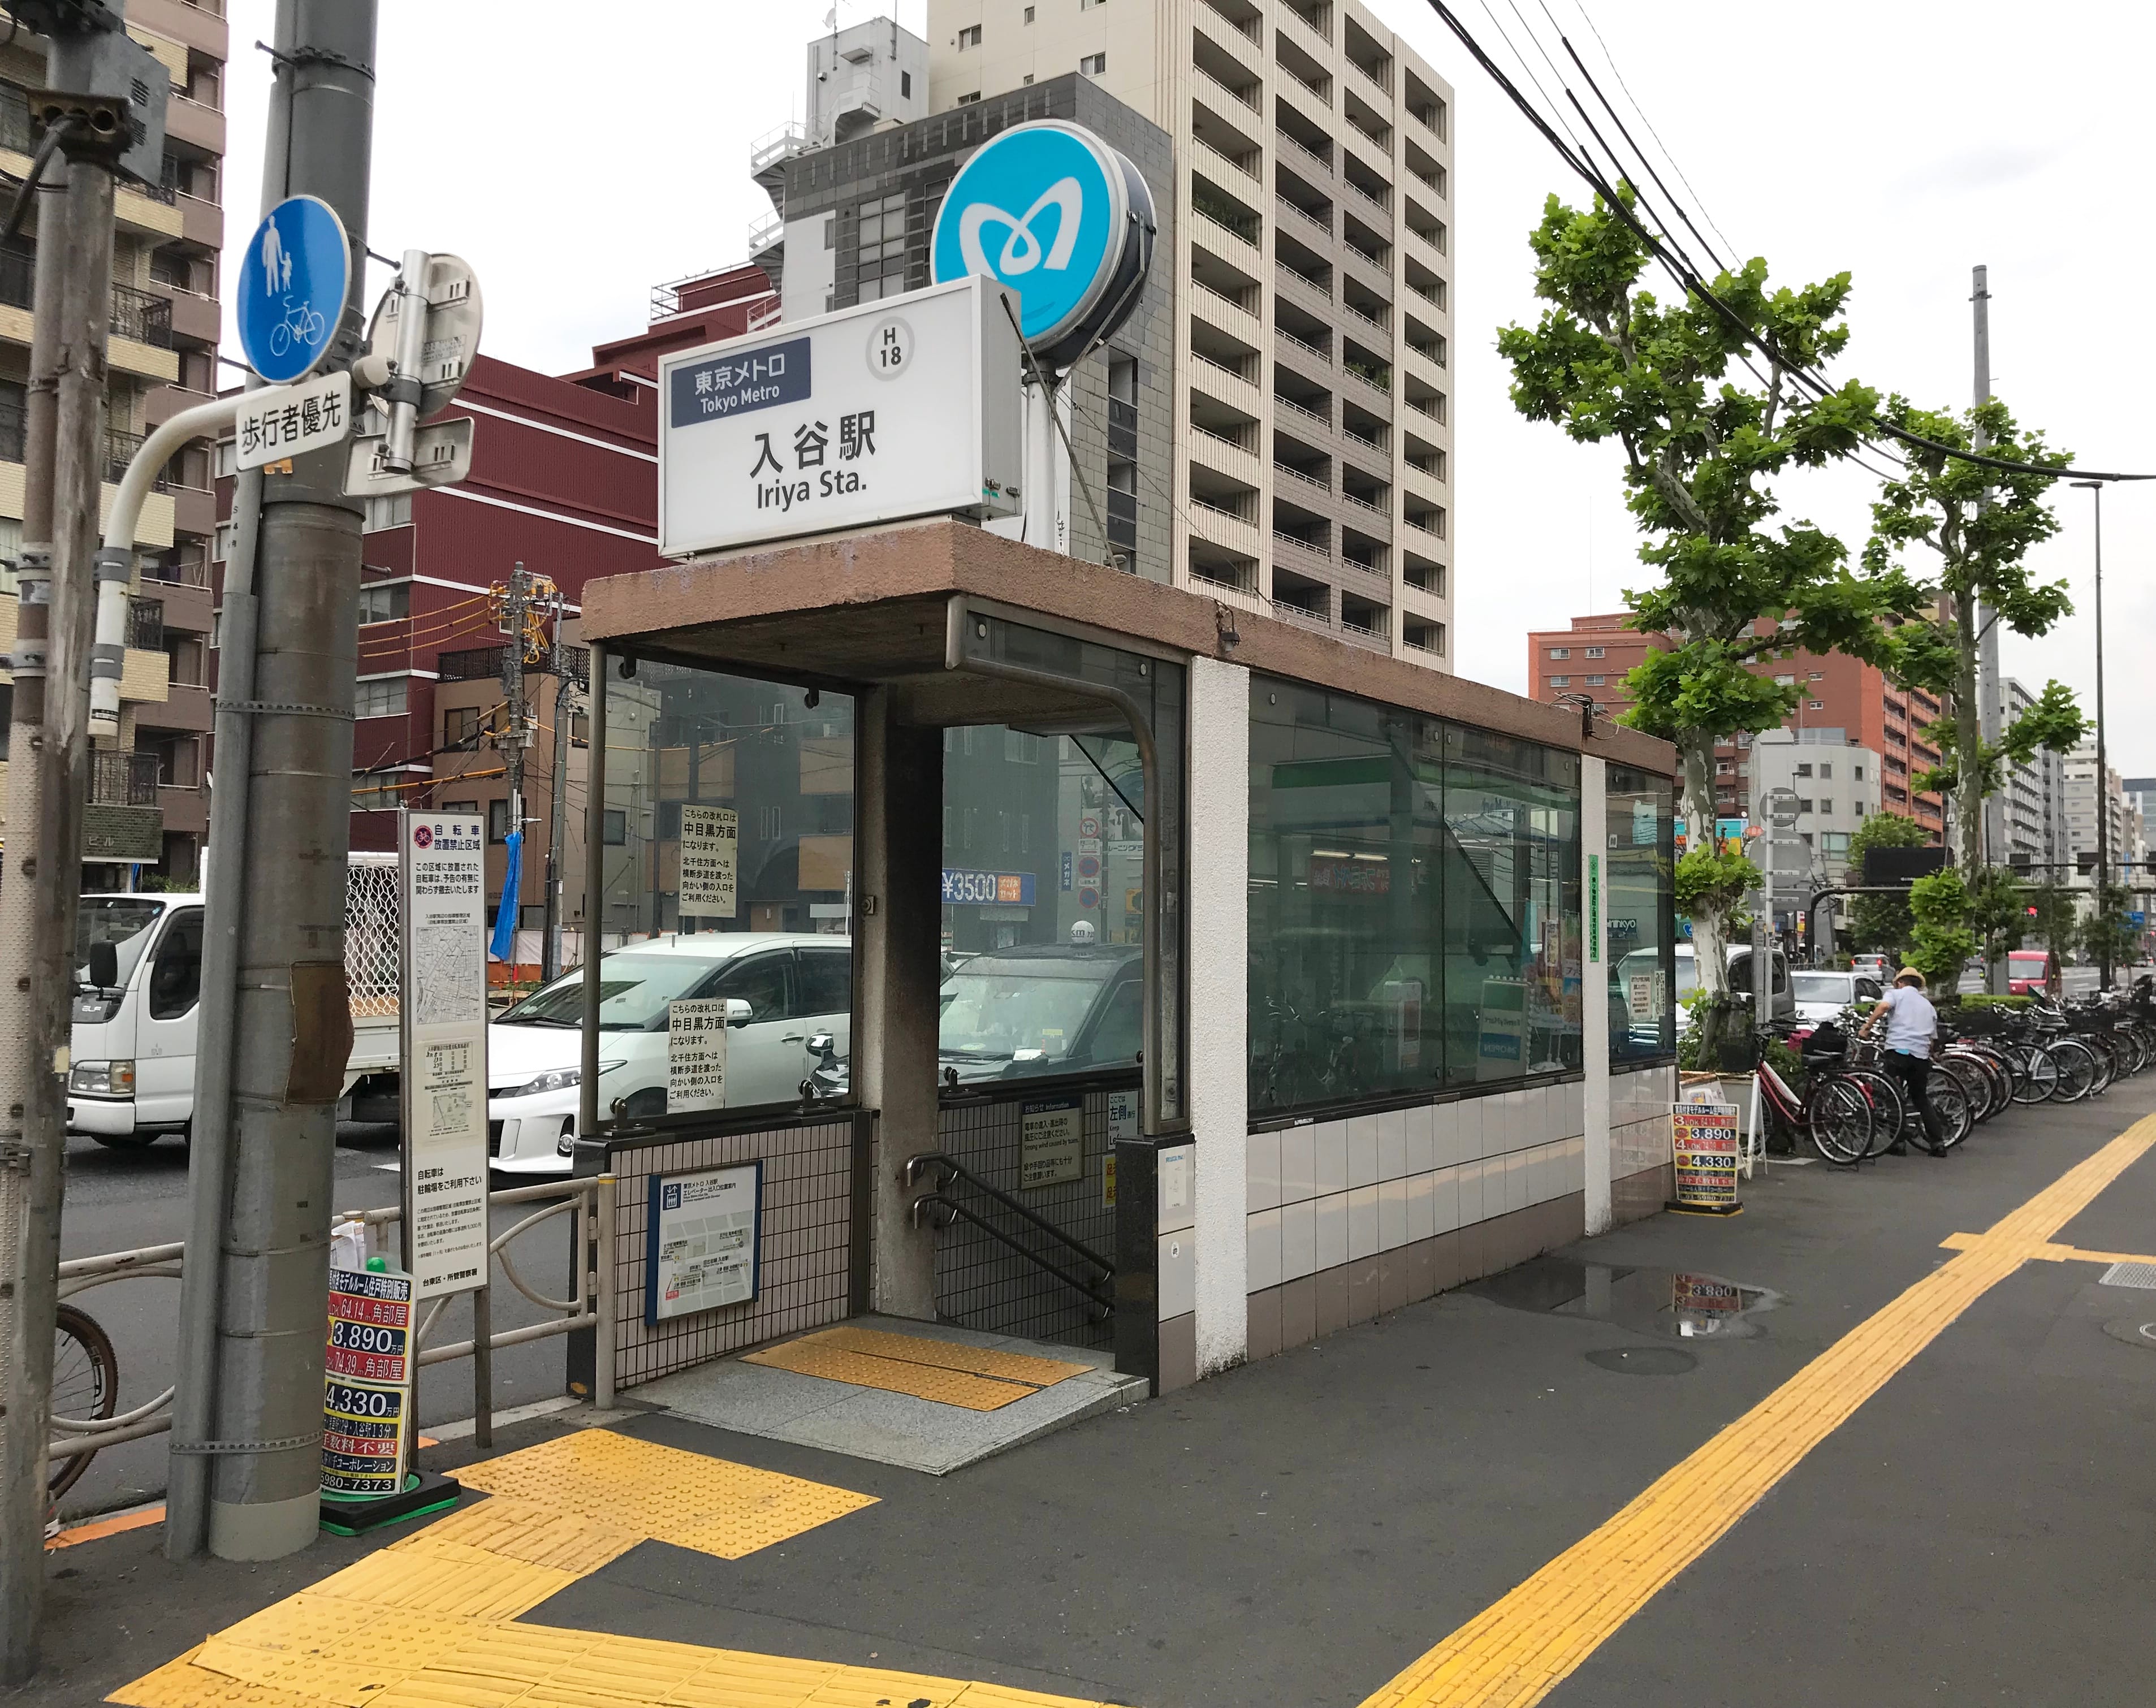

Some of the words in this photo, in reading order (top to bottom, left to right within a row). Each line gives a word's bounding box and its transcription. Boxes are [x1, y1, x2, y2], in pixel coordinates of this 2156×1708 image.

[883, 327, 896, 344] H
[880, 347, 901, 367] 18
[694, 353, 785, 396] 東京メトロ
[701, 389, 738, 414] Tokyo
[741, 384, 779, 406] Metro
[242, 390, 340, 455] 歩行者優先
[750, 410, 876, 479] 入谷駅
[758, 479, 809, 512] Iriya
[820, 470, 867, 498] Sta.
[685, 809, 736, 822] こちらの改札口は
[435, 825, 479, 836] 自転車
[684, 821, 736, 839] 中目黒方面
[434, 839, 480, 850] 放置禁止区域
[682, 840, 719, 852] になります。
[416, 863, 479, 871] この区域に放置された
[682, 857, 729, 868] 北千住方面へは
[682, 869, 733, 880] 横断歩道を渡った
[682, 881, 734, 892] 向かい側の入口を
[942, 872, 996, 901] ¥3500
[682, 893, 726, 904] ご利用ください。
[672, 1004, 725, 1014] こちらの改札口は
[672, 1017, 725, 1031] 中目黒方面
[671, 1035, 707, 1046] になります。
[671, 1052, 718, 1062] 北千住方面へは
[670, 1063, 721, 1075] 横断歩道を渡った
[670, 1075, 723, 1087] 向かい側の入口を
[669, 1088, 714, 1099] ご利用ください。
[1025, 1104, 1044, 1113] お知らせ
[1109, 1104, 1135, 1121] 左側通行
[1109, 1134, 1122, 1145] Le
[418, 1168, 444, 1181] 自転車は
[417, 1176, 482, 1195] 駐輪場をご利用下さい
[371, 1303, 407, 1325] 角部屋
[365, 1357, 403, 1380] 角部屋
[323, 1433, 395, 1455] 手数料不要
